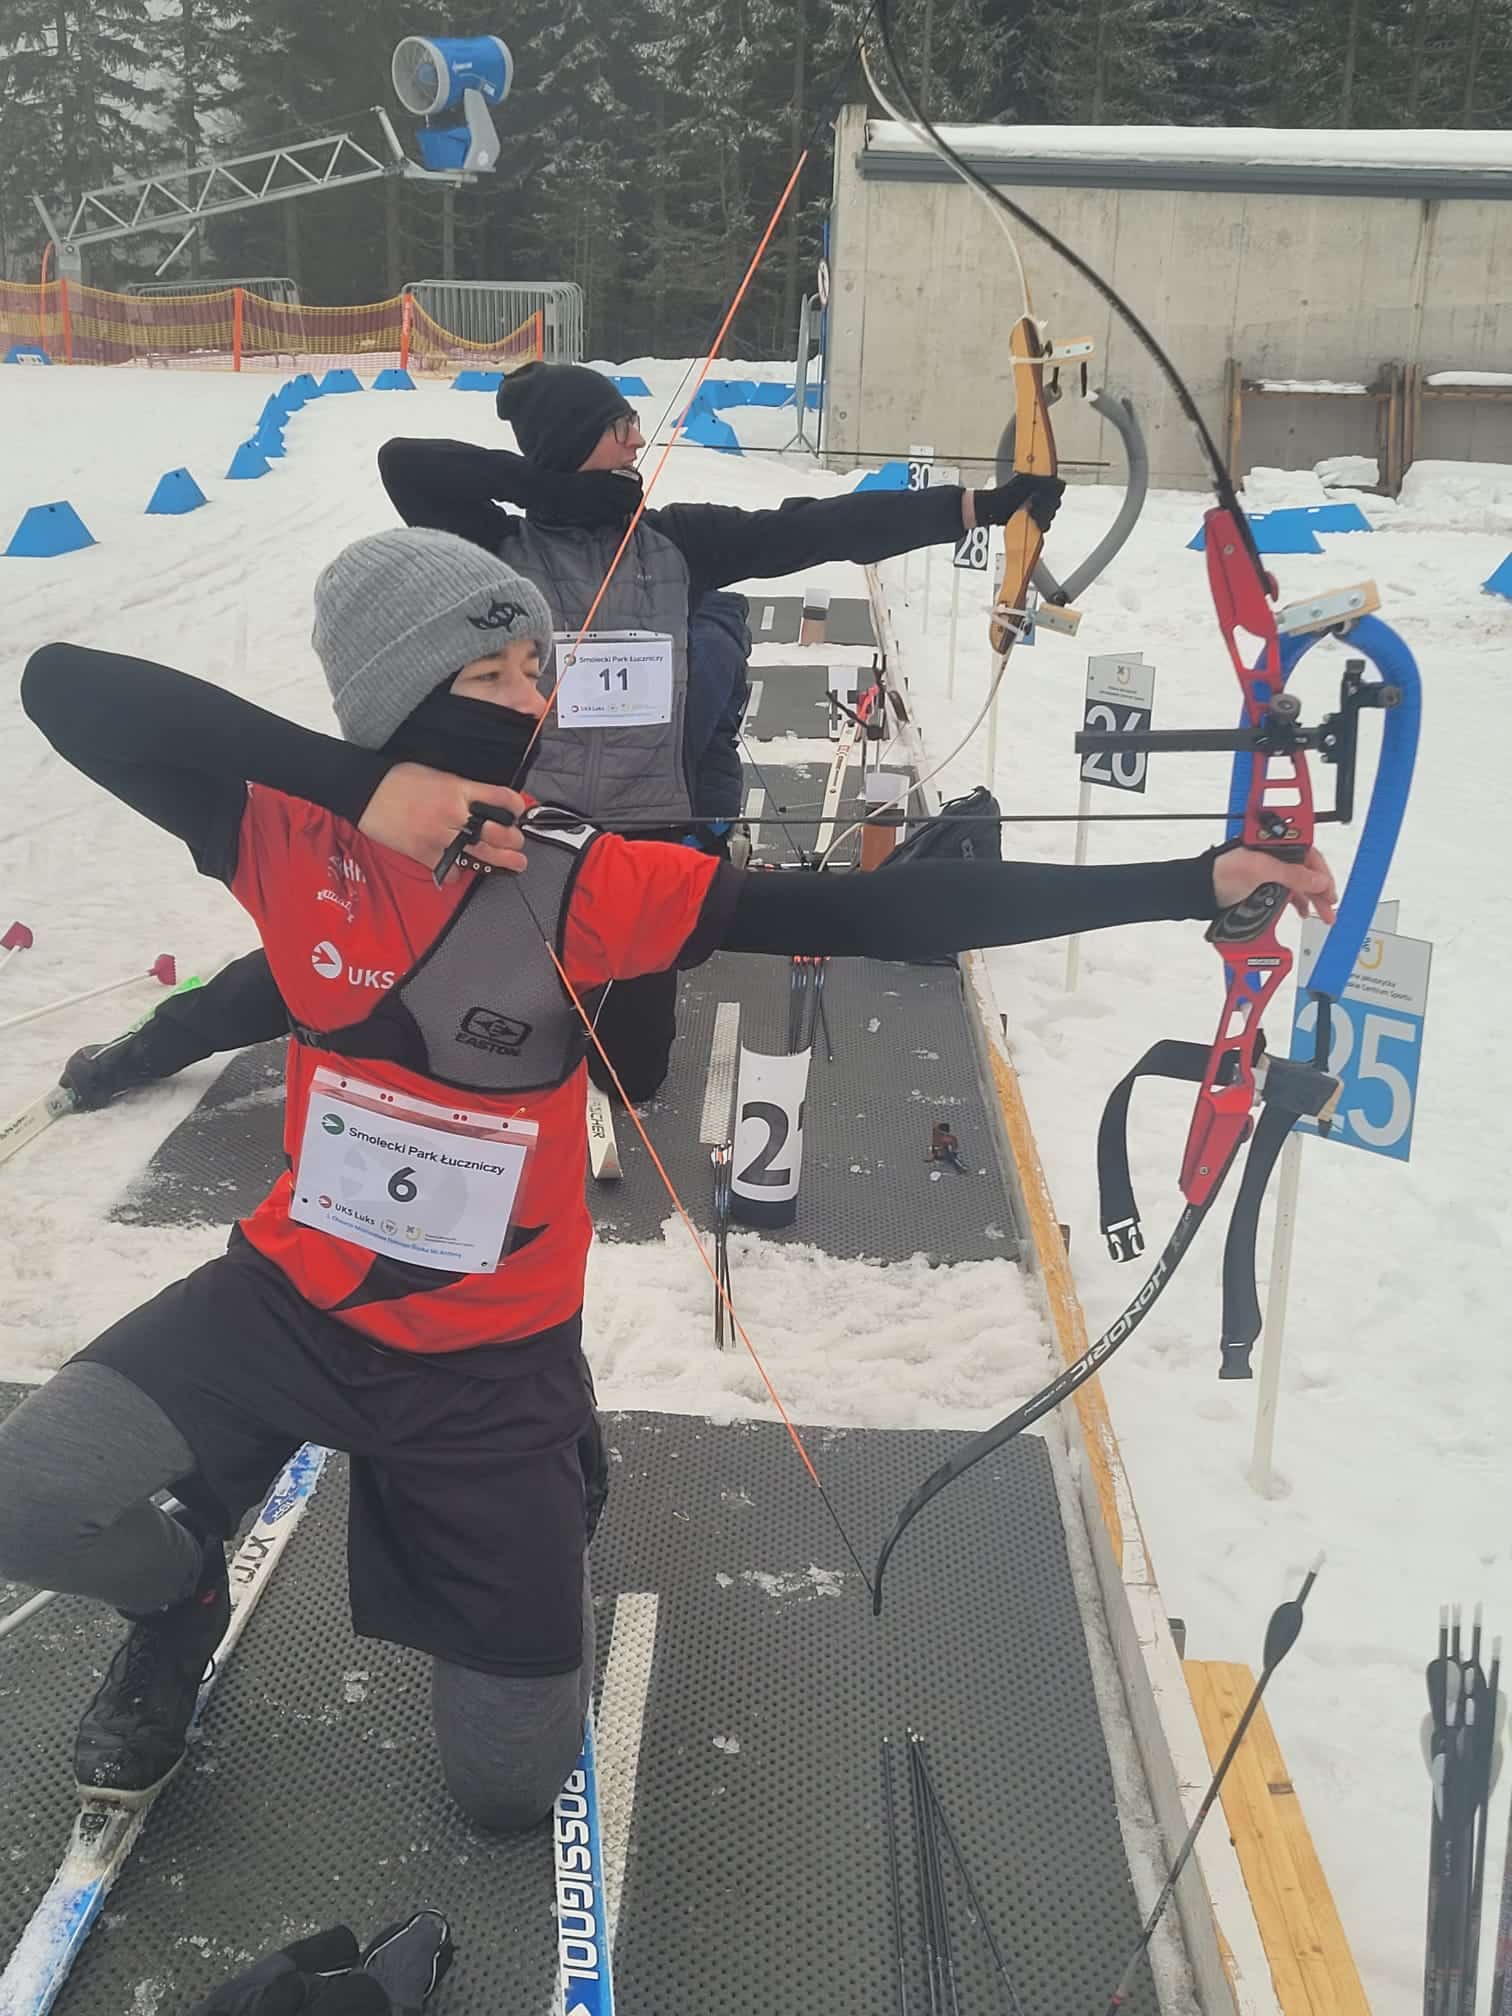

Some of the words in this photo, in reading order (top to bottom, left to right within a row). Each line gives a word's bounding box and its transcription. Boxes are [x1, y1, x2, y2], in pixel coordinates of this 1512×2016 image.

[908, 463, 932, 491] 30
[954, 526, 990, 568] 28
[599, 667, 628, 691] 11
[348, 966, 396, 990] UKS
[349, 1127, 406, 1154] Smolecki
[407, 1145, 438, 1163] Park
[440, 1154, 505, 1176] Łuczniczy
[736, 1101, 791, 1187] 2
[387, 1166, 418, 1203] 6
[335, 1203, 353, 1217] UKS
